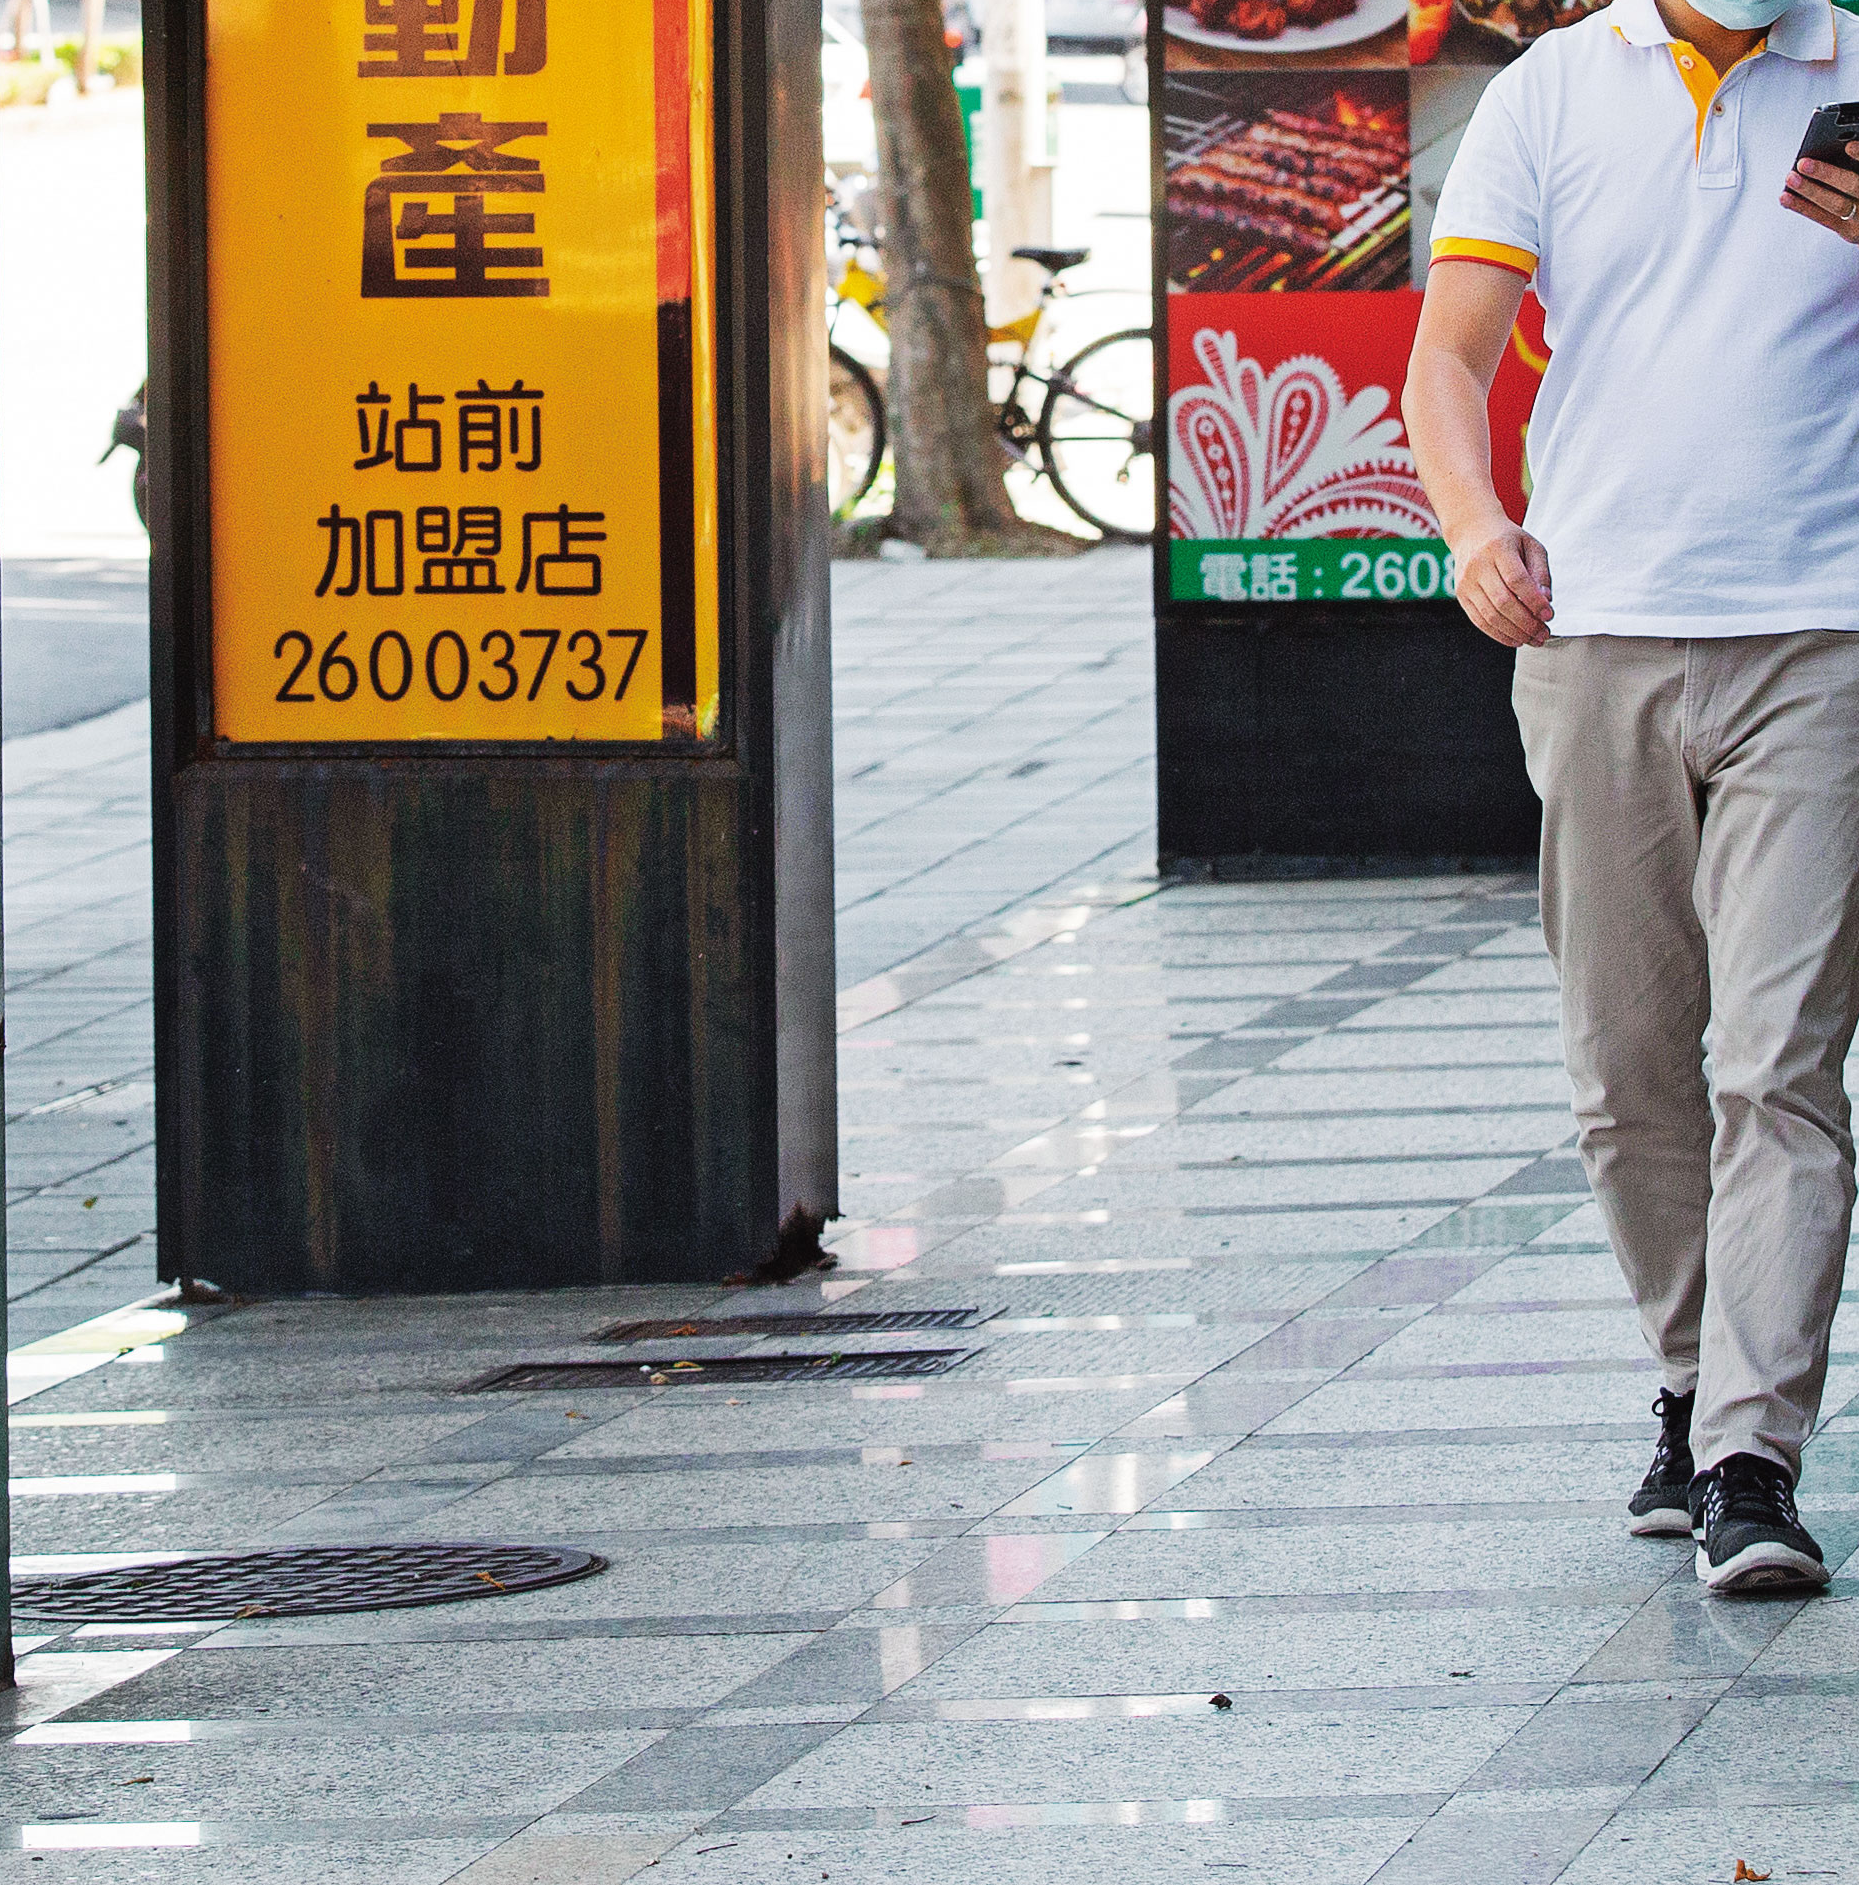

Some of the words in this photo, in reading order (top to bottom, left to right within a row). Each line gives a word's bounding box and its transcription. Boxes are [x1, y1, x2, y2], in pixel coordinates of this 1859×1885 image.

[353, 378, 545, 473] 站前
[315, 503, 608, 597] 加盟店
[273, 627, 650, 704] 26003737
